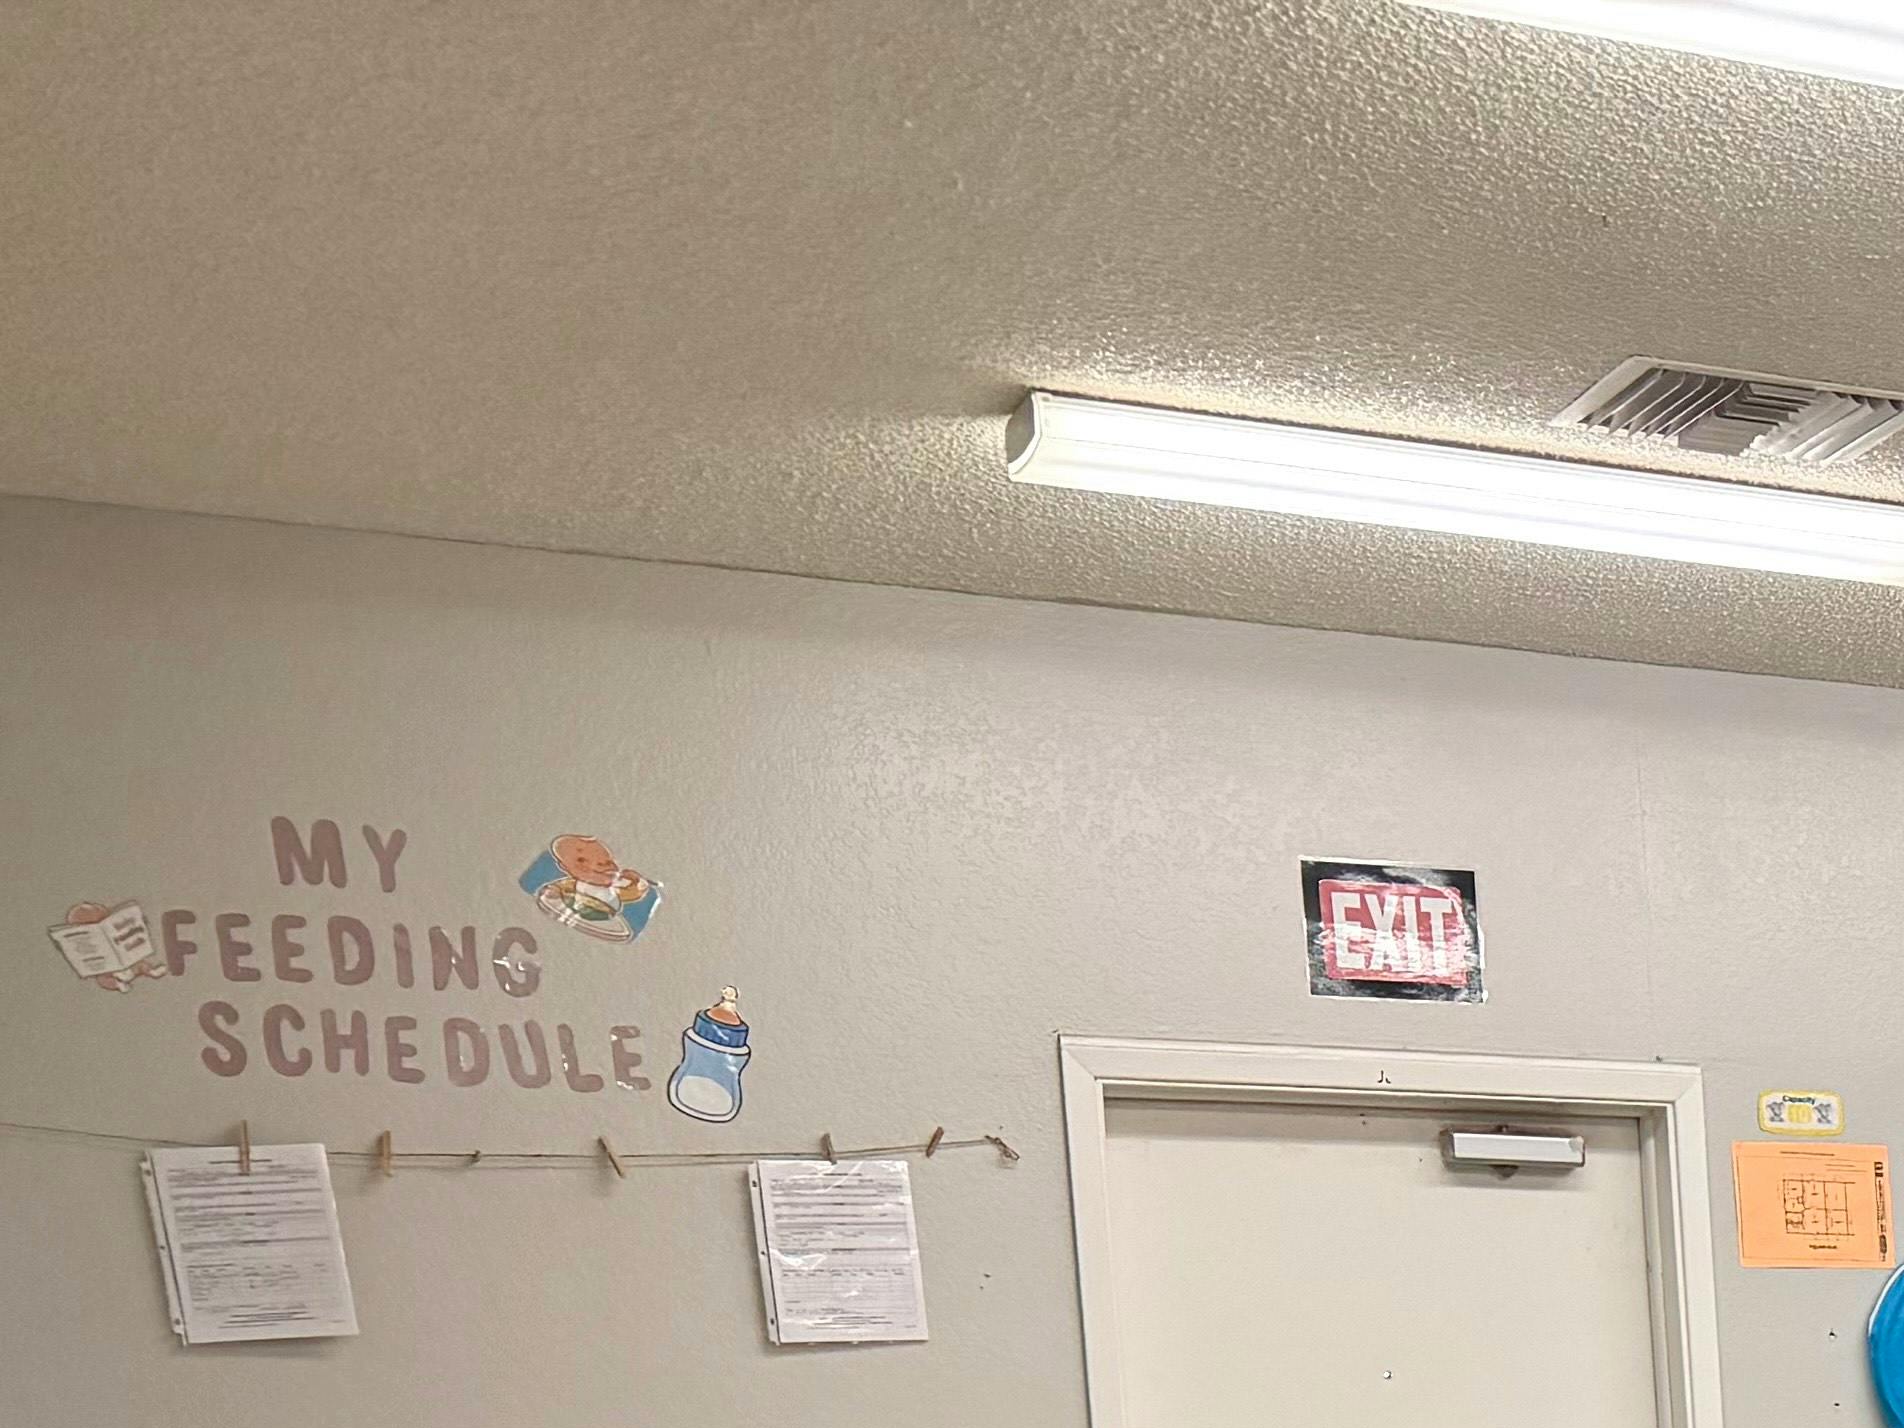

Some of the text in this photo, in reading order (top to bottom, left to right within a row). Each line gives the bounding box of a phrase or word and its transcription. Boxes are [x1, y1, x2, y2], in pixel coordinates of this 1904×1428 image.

[270, 815, 407, 893] MY
[161, 908, 542, 998] FEEDING
[1330, 891, 1454, 977] EXIT
[198, 1001, 652, 1093] SCHEDULE
[1782, 1095, 1816, 1105] Capacity
